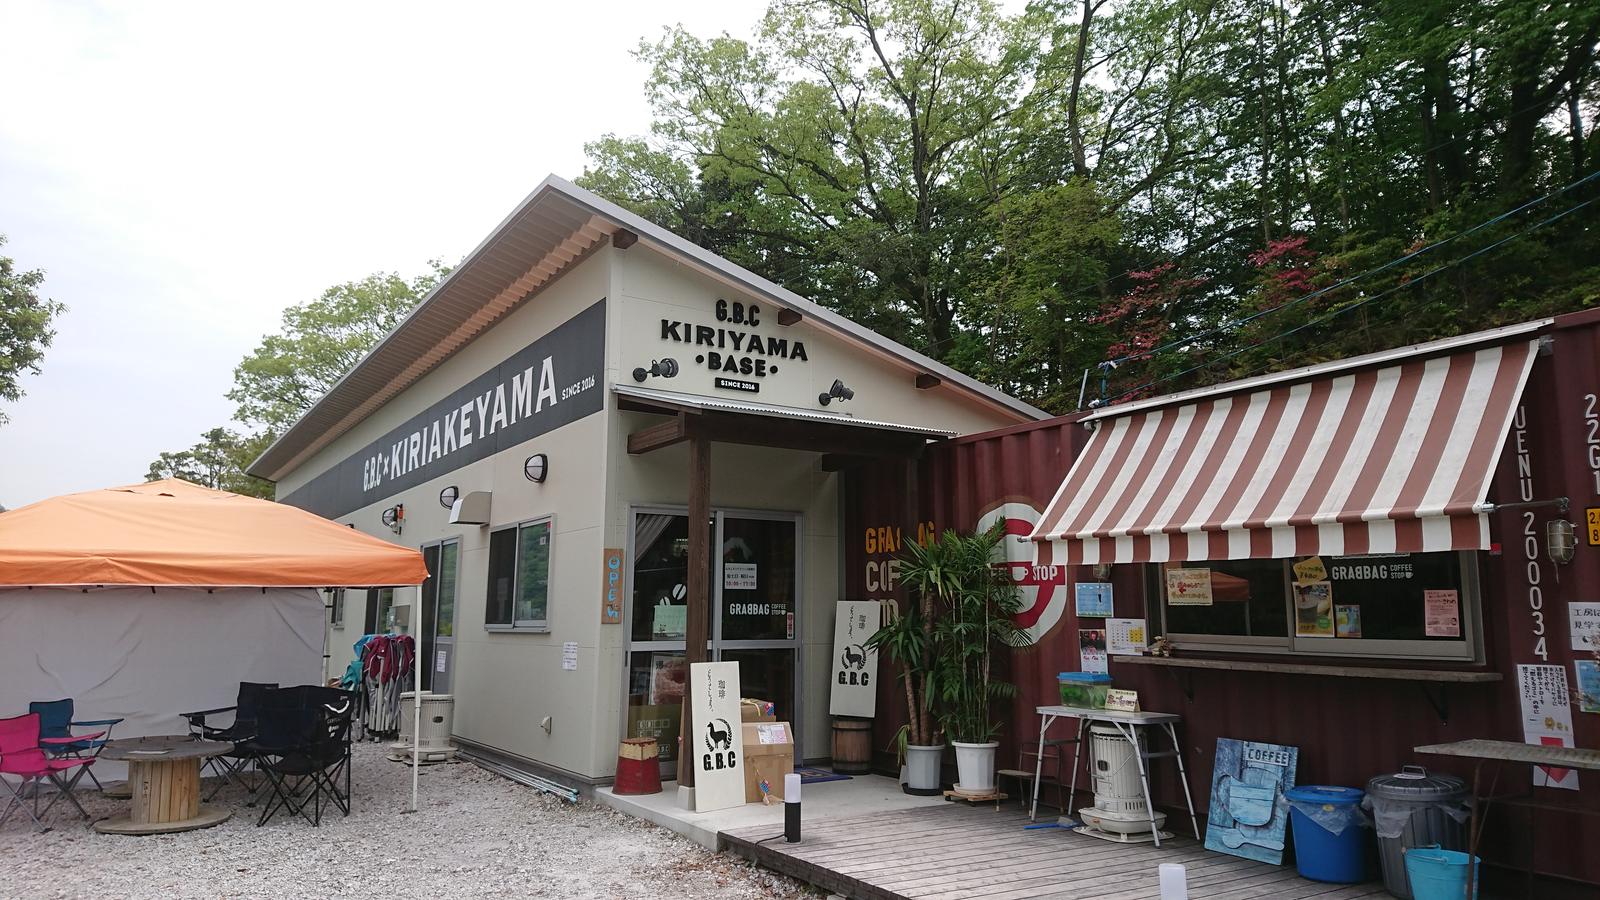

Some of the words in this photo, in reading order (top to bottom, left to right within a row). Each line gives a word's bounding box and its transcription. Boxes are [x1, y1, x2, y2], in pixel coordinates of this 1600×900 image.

[716, 299, 760, 327] G.B.C
[661, 319, 808, 361] KIRIYAMA
[720, 379, 741, 389] SINCE
[741, 382, 756, 390] 2016
[363, 452, 383, 492] G.B.C
[390, 355, 558, 481] KIRIAKEYAMA
[562, 381, 580, 400] SINCE
[581, 374, 595, 391] 2016
[1033, 565, 1058, 581] STOP
[1332, 565, 1388, 581] GRABBAG
[1390, 563, 1413, 573] COFFEE
[1391, 572, 1405, 580] STOP
[729, 603, 770, 616] GRABBAG
[838, 671, 869, 687] G.B.C
[703, 751, 736, 771] G.B.C
[1247, 749, 1289, 766] COFFEE
